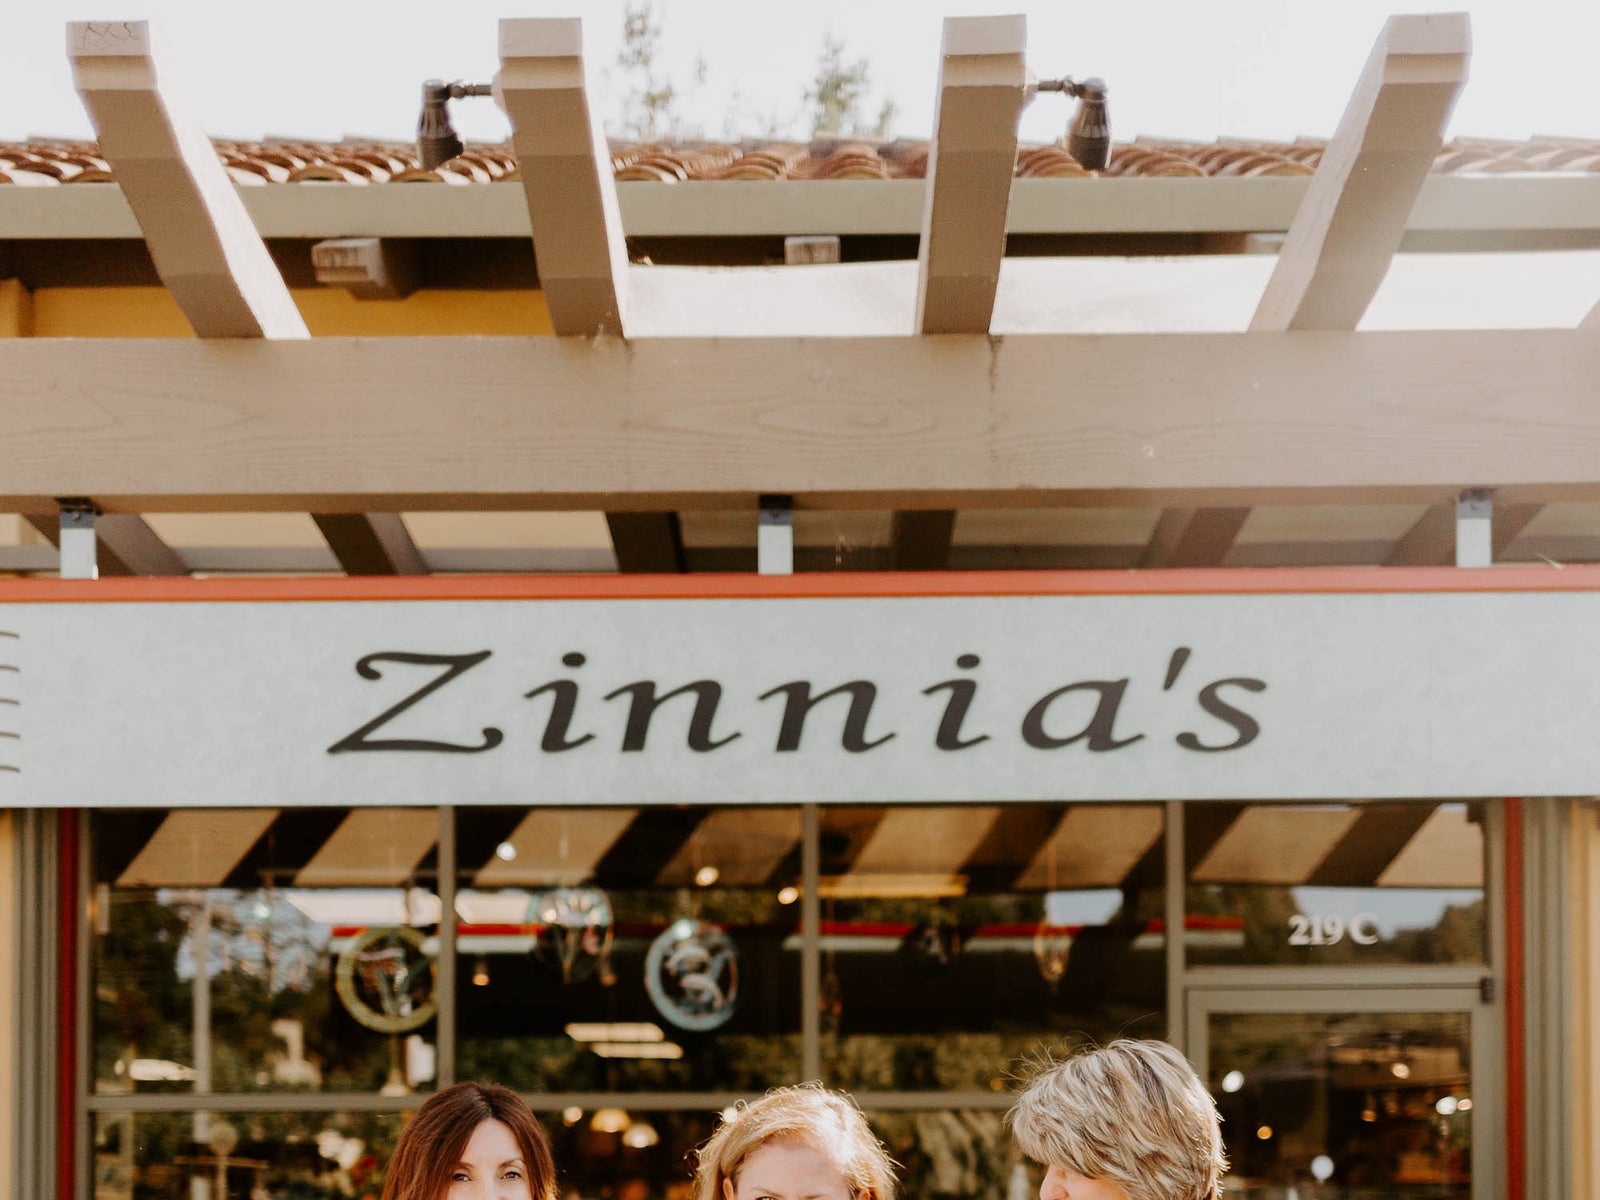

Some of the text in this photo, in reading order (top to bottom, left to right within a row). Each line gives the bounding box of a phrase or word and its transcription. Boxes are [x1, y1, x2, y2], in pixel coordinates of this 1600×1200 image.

[327, 646, 1268, 754] Zinnia's
[1288, 912, 1378, 946] 219 C
